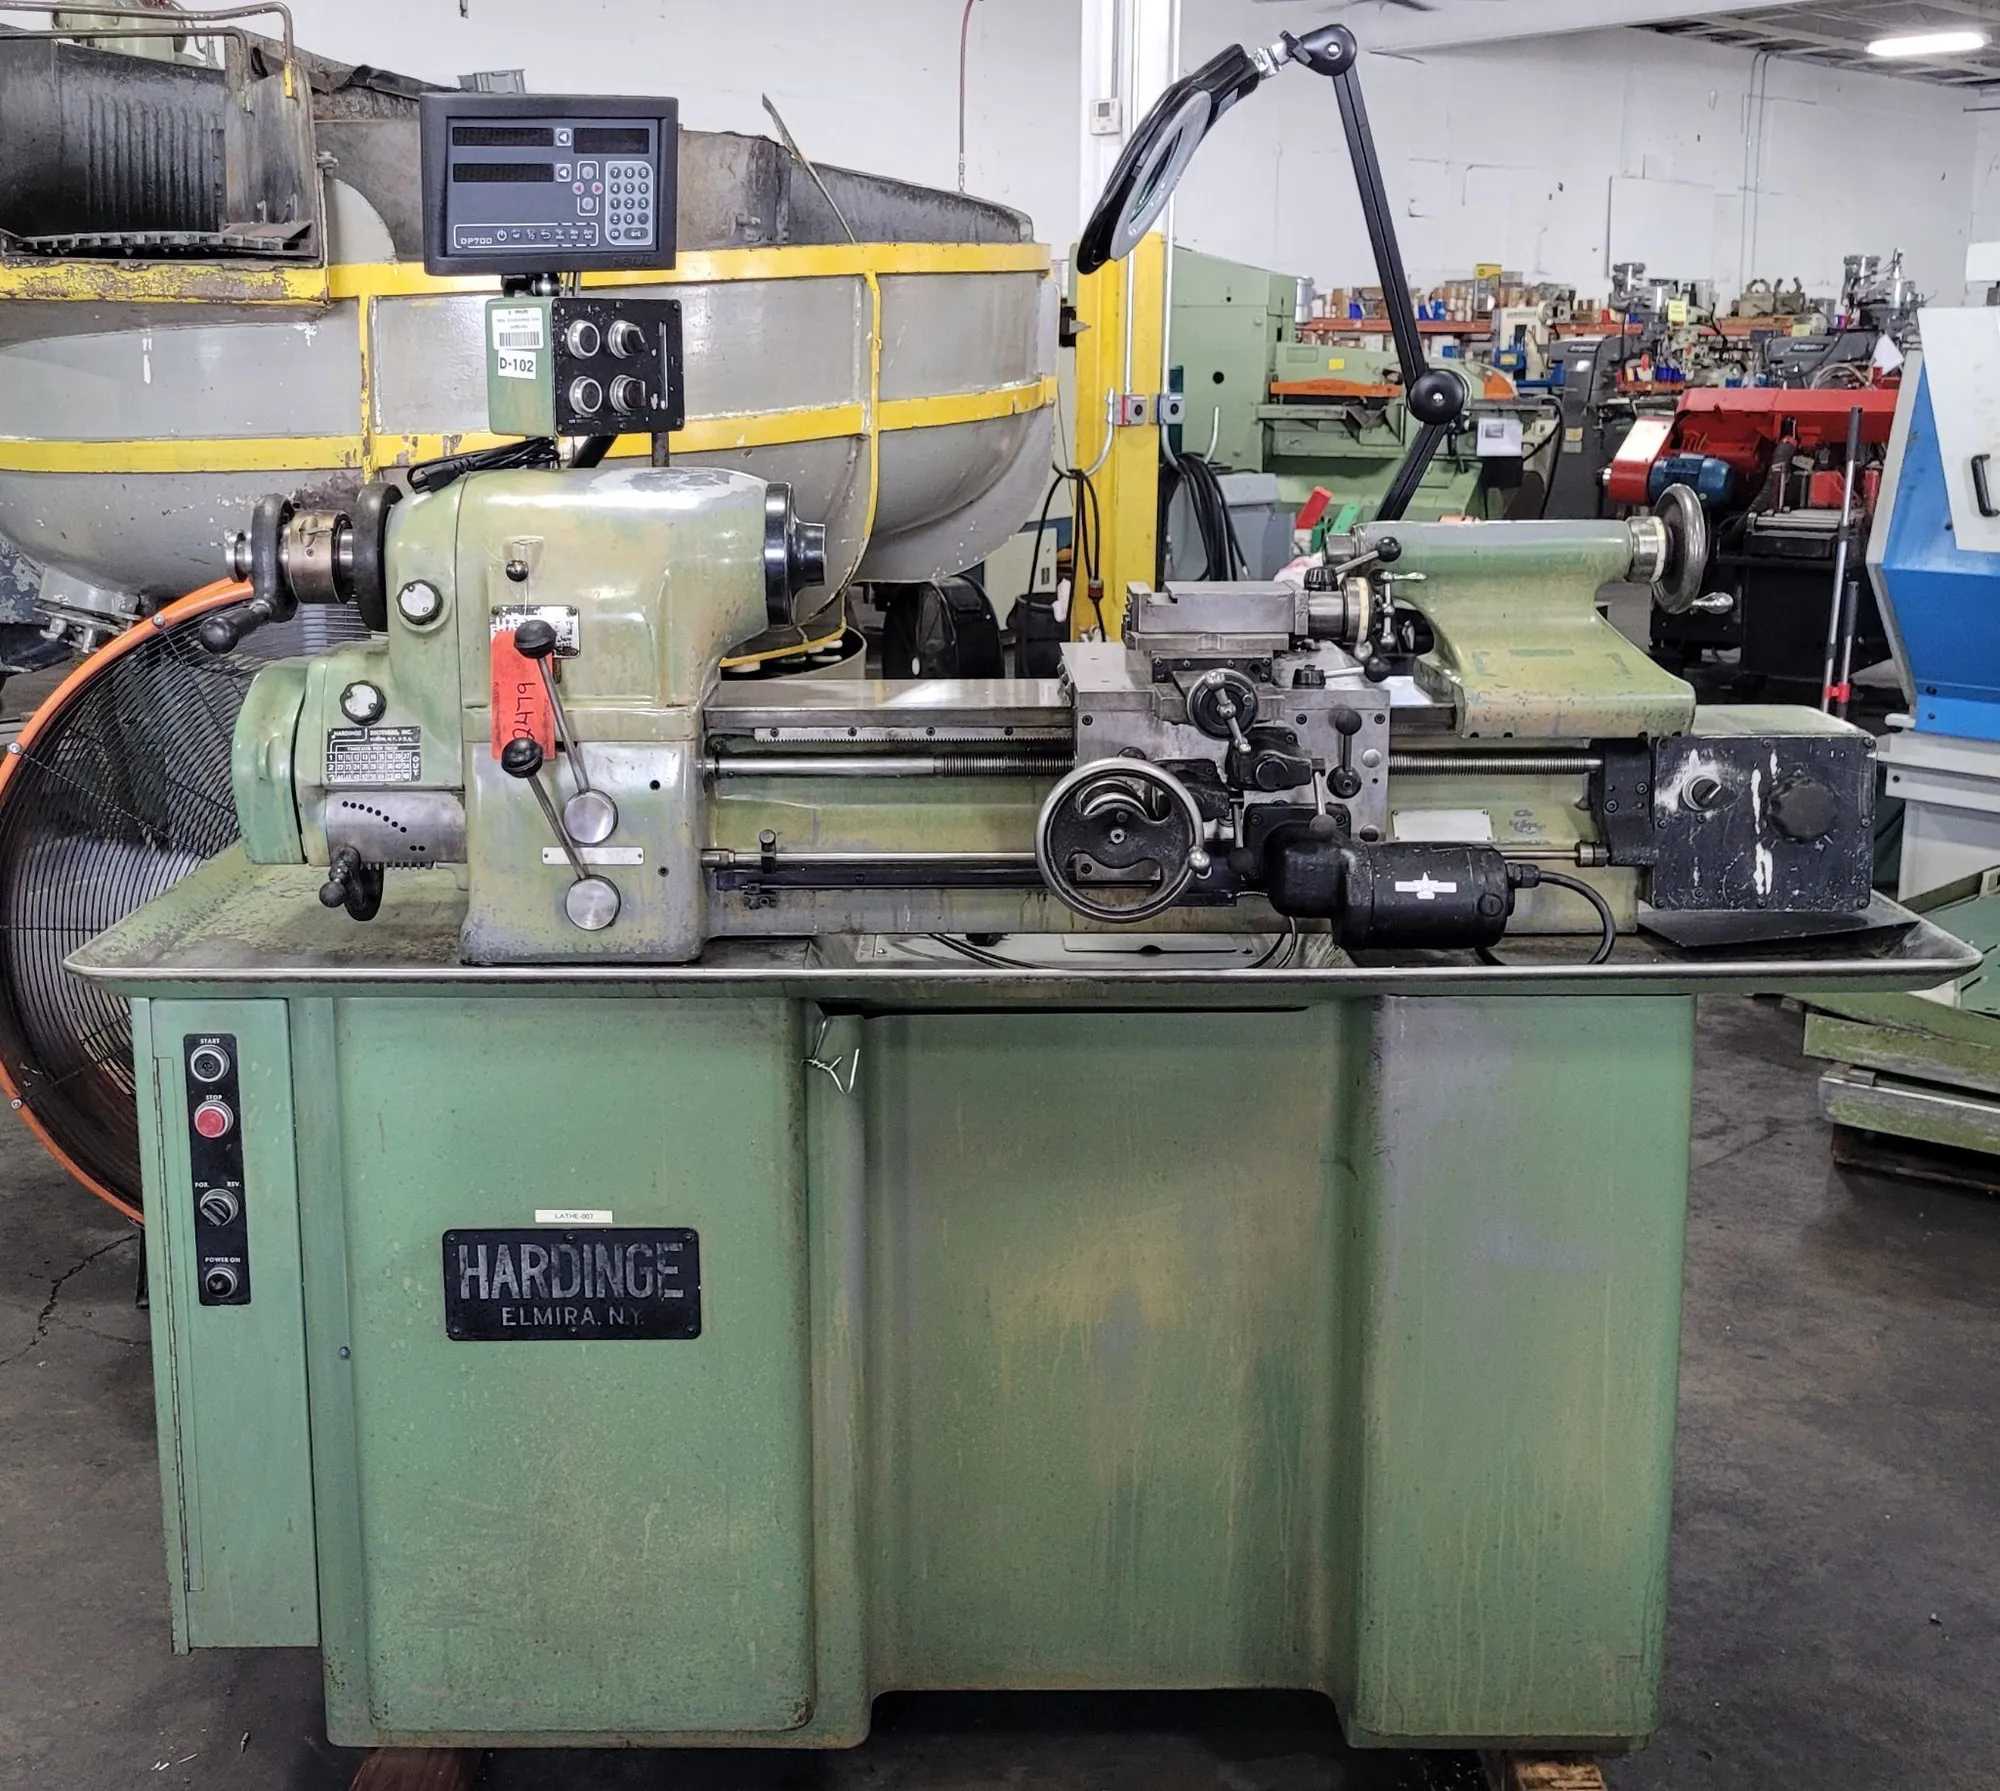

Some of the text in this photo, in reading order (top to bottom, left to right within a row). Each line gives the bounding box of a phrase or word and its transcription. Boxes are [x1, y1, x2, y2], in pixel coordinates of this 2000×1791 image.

[460, 236, 493, 245] DP700
[499, 357, 534, 373] D-102
[458, 1242, 684, 1300] HARDINGE
